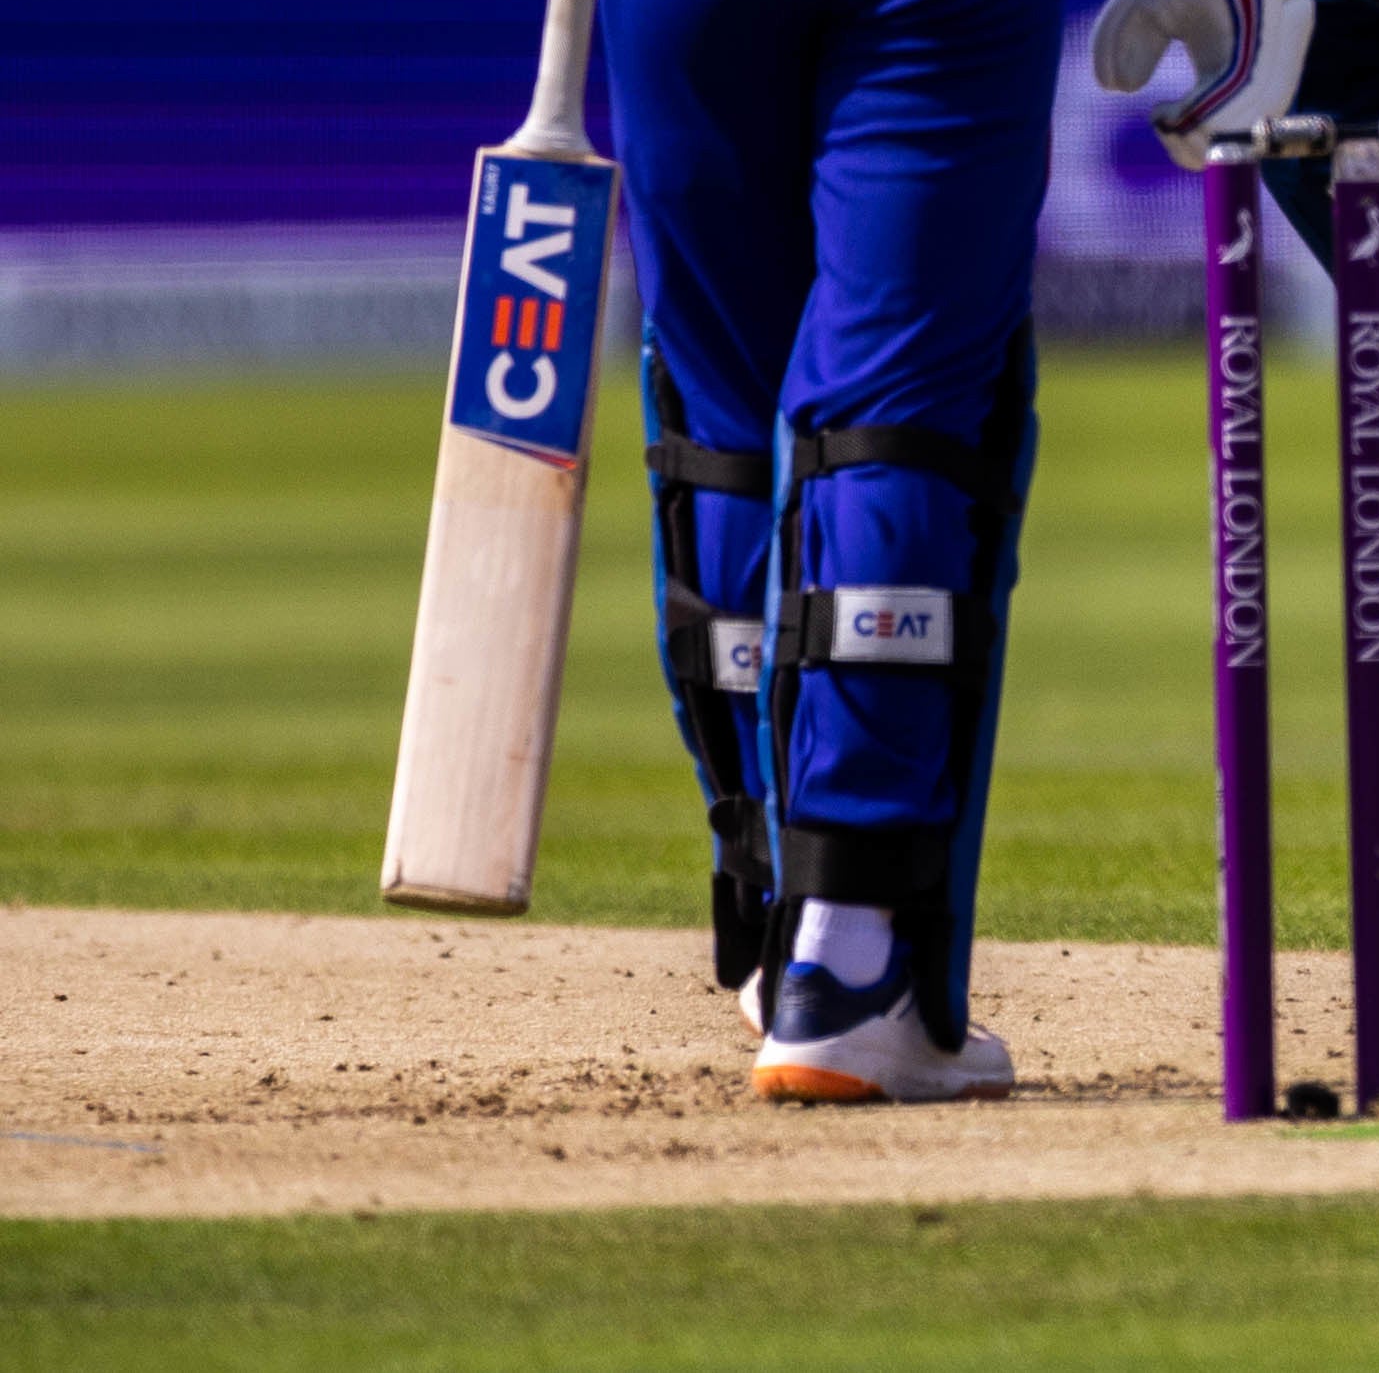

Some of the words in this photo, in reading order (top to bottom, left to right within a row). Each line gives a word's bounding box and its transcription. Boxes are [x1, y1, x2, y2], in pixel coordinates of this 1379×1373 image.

[485, 184, 575, 420] CEAT
[1220, 315, 1260, 460] ROYAL
[853, 610, 933, 640] CEAT
[1221, 470, 1264, 668] LONDON
[731, 644, 763, 671] CE
